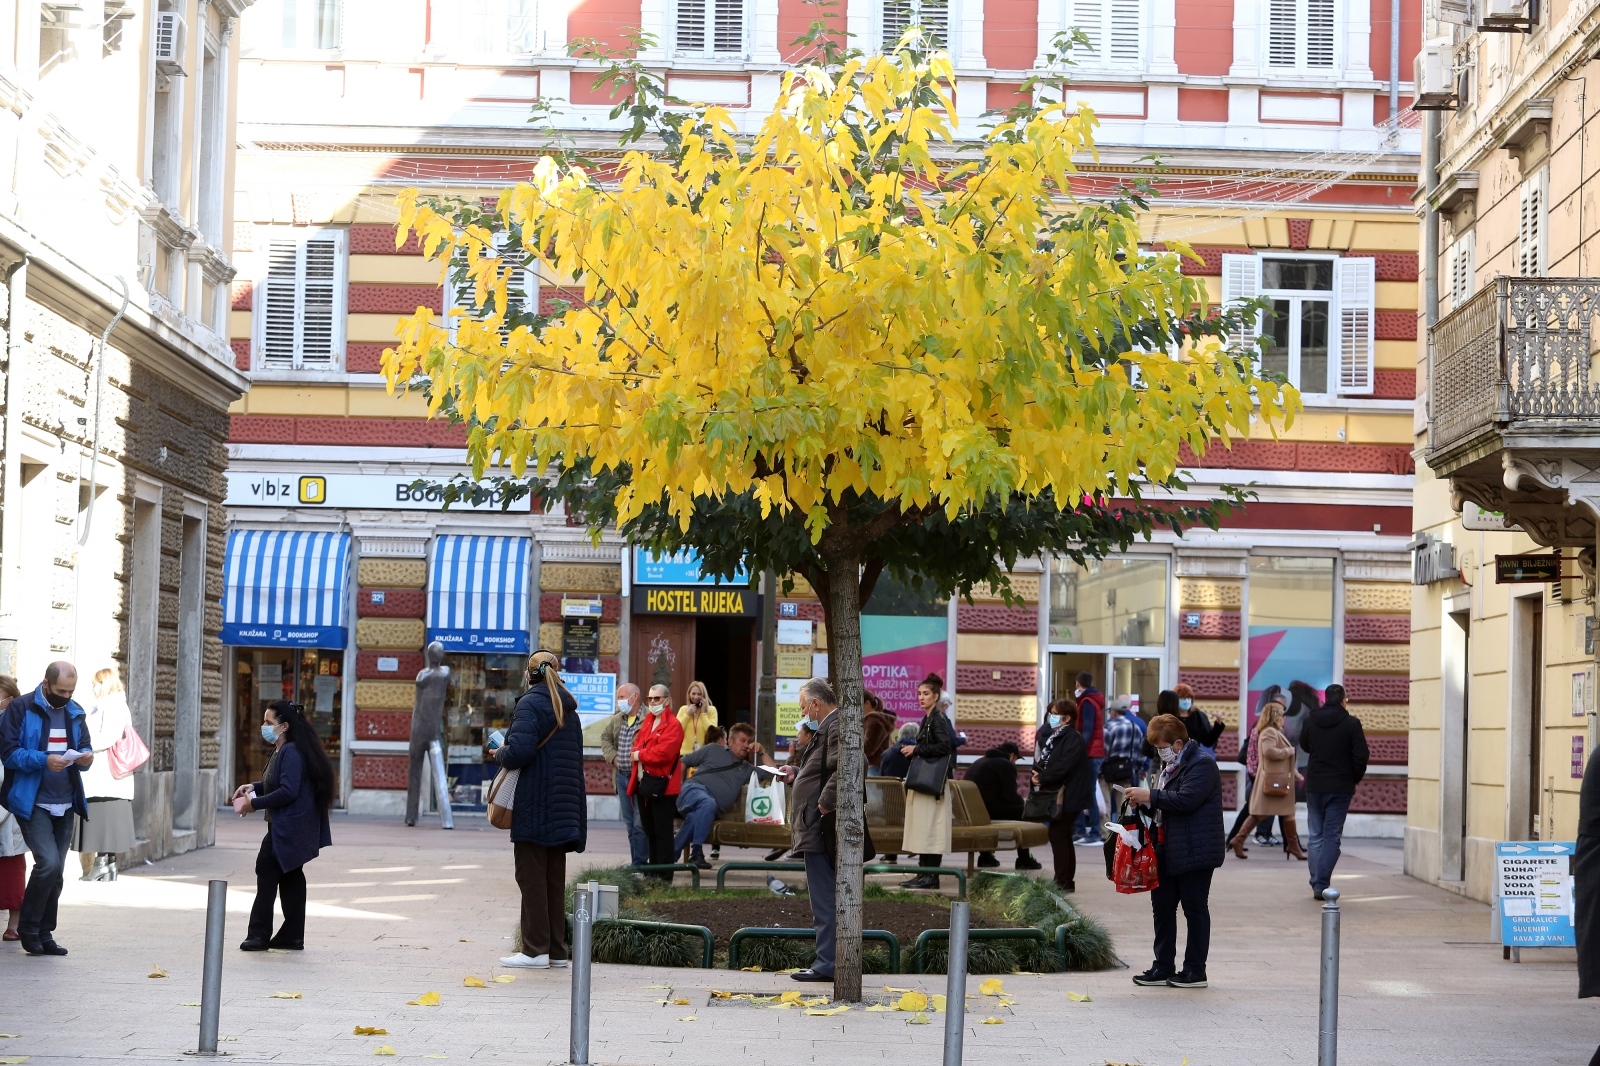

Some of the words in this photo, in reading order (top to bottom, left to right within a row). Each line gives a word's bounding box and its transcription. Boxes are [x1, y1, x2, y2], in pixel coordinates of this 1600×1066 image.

[1499, 560, 1519, 568] JAVNI
[1522, 557, 1558, 568] BILJEŽNIK
[647, 589, 697, 612] HOSTEL
[701, 591, 744, 613] RIJEKA
[783, 604, 795, 613] 32
[239, 629, 267, 637] KNJIŽARA
[435, 634, 463, 642] KNJIŽARA
[862, 665, 909, 678] OPTIKA
[582, 676, 608, 685] KORZO
